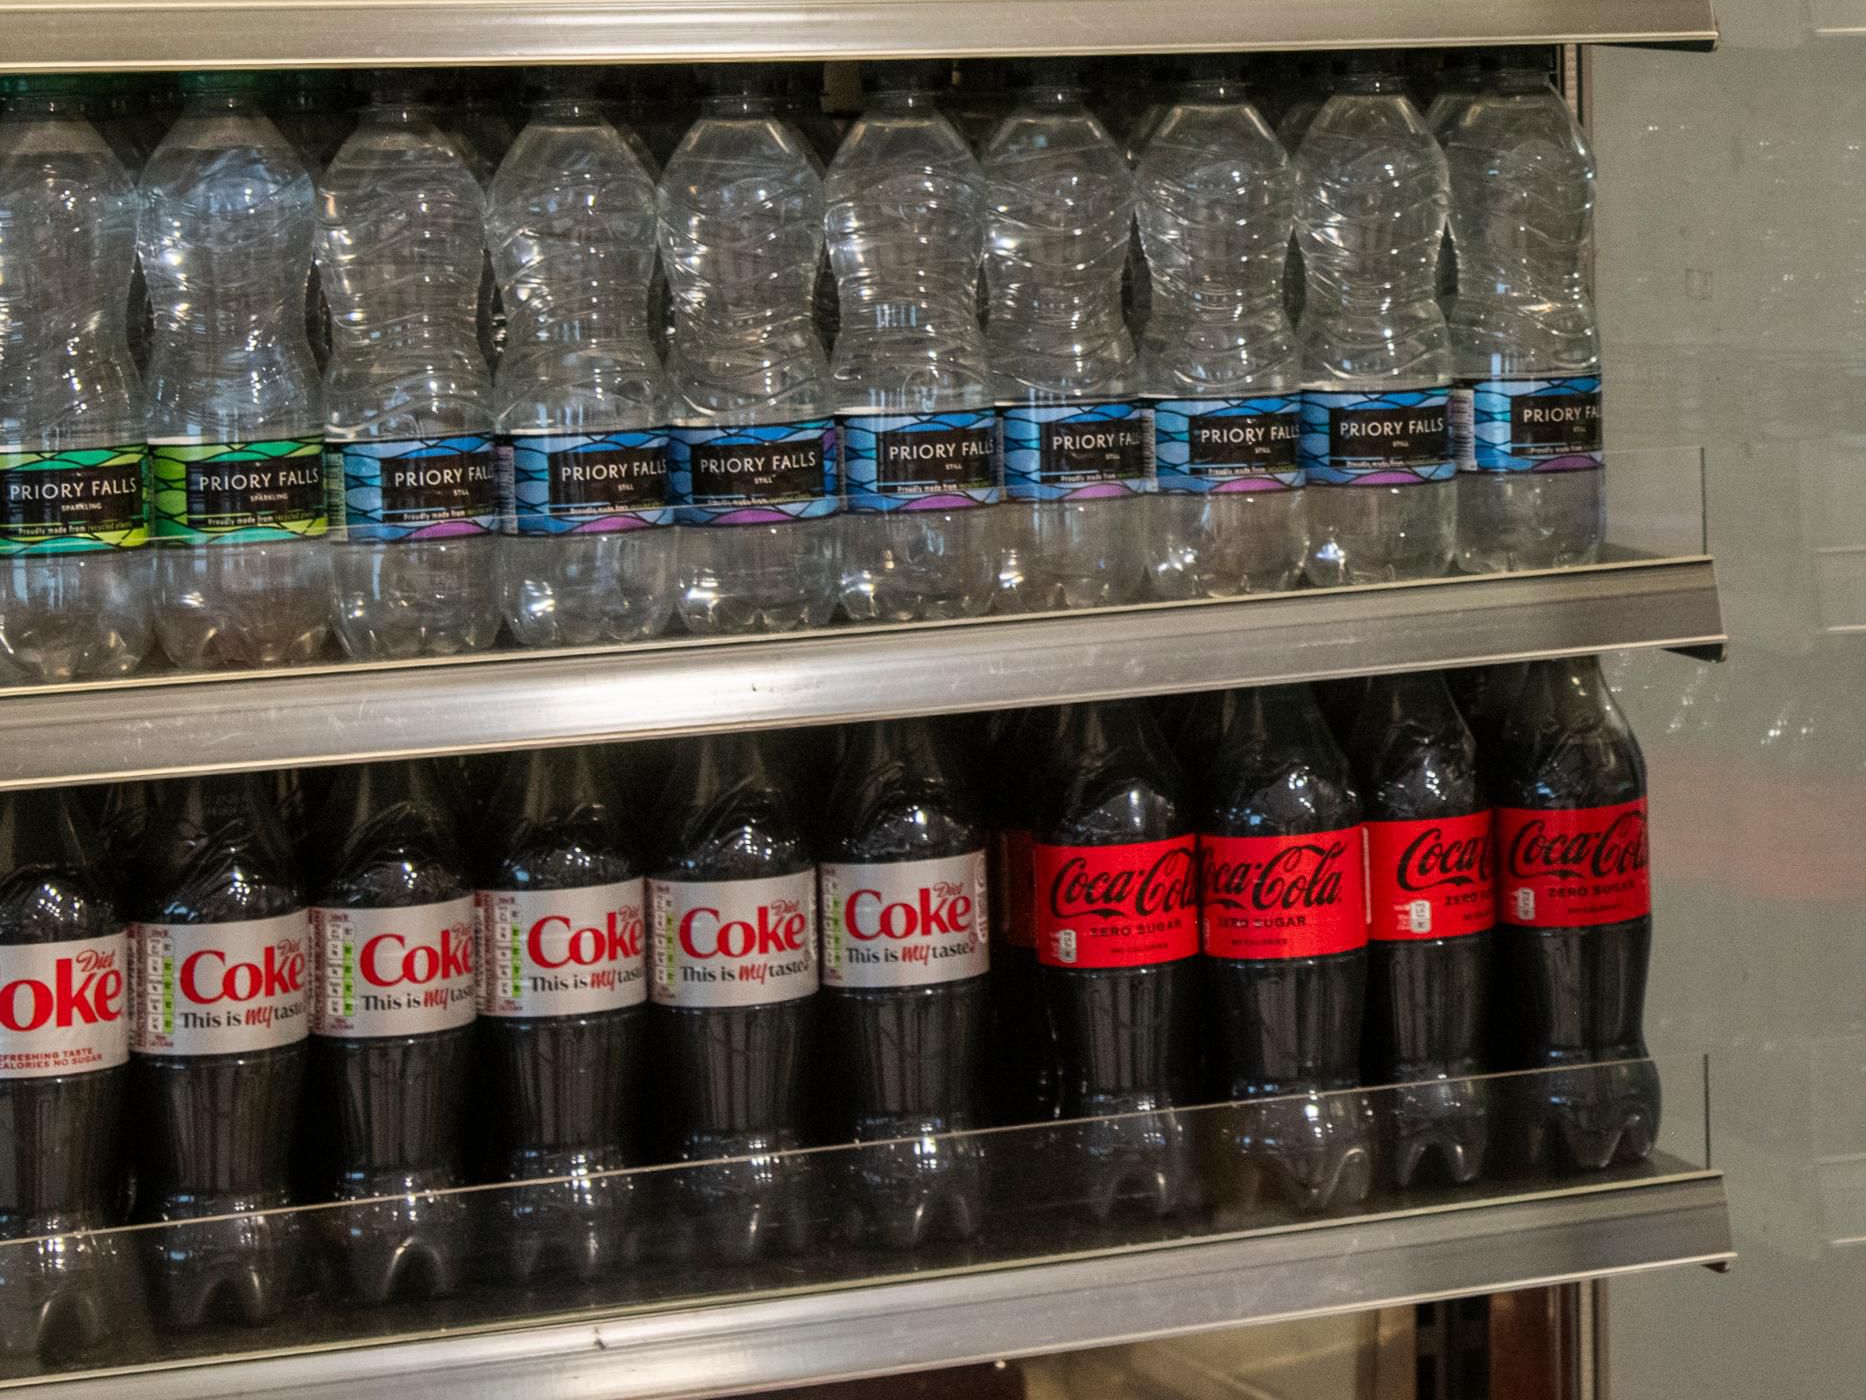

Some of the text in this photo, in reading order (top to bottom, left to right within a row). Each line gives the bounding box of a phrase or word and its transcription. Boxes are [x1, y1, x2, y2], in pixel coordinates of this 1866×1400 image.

[1523, 407, 1581, 424] PRIORY
[1201, 424, 1301, 444] PRIORY FALLS
[1340, 417, 1445, 437] PRIORY FALLS
[889, 443, 955, 461] PRIORY
[1052, 434, 1115, 451] PRIORY
[561, 458, 667, 482] PRIORY FALLS
[700, 451, 817, 474] PRIORY FALLS
[199, 467, 320, 491] PRIORY FALLS
[394, 468, 463, 488] PRIORY
[9, 477, 138, 501] PRIORY FALLS
[249, 492, 290, 502] SPARKLING
[61, 502, 103, 513] SPARKLING
[17, 525, 46, 537] Proudly
[47, 525, 68, 535] made
[68, 524, 87, 534] from
[207, 514, 274, 527] Proudly made from
[932, 880, 965, 898] Diet
[1547, 886, 1589, 899] ZERO
[1444, 892, 1478, 908] ZERO
[844, 886, 972, 942] Coke
[1253, 914, 1308, 930] SUGAR
[678, 905, 806, 960] Coke
[1089, 918, 1183, 938] ZERO SUGAR
[527, 910, 644, 970] Coke
[76, 949, 116, 972] Diet
[846, 946, 881, 964] This
[883, 945, 899, 962] is
[901, 943, 930, 966] my
[179, 944, 306, 1005] Coke
[528, 967, 617, 993] This is my
[680, 965, 717, 983] This
[720, 964, 736, 981] is
[738, 961, 768, 985] my
[0, 957, 123, 1033] oke
[360, 986, 449, 1012] This is my
[180, 1012, 222, 1030] This
[226, 1009, 242, 1027] is
[244, 1005, 272, 1029] my
[0, 1047, 94, 1062] EFRESHING TASTE
[53, 1058, 70, 1067] NO
[70, 1053, 103, 1067] SUGAR
